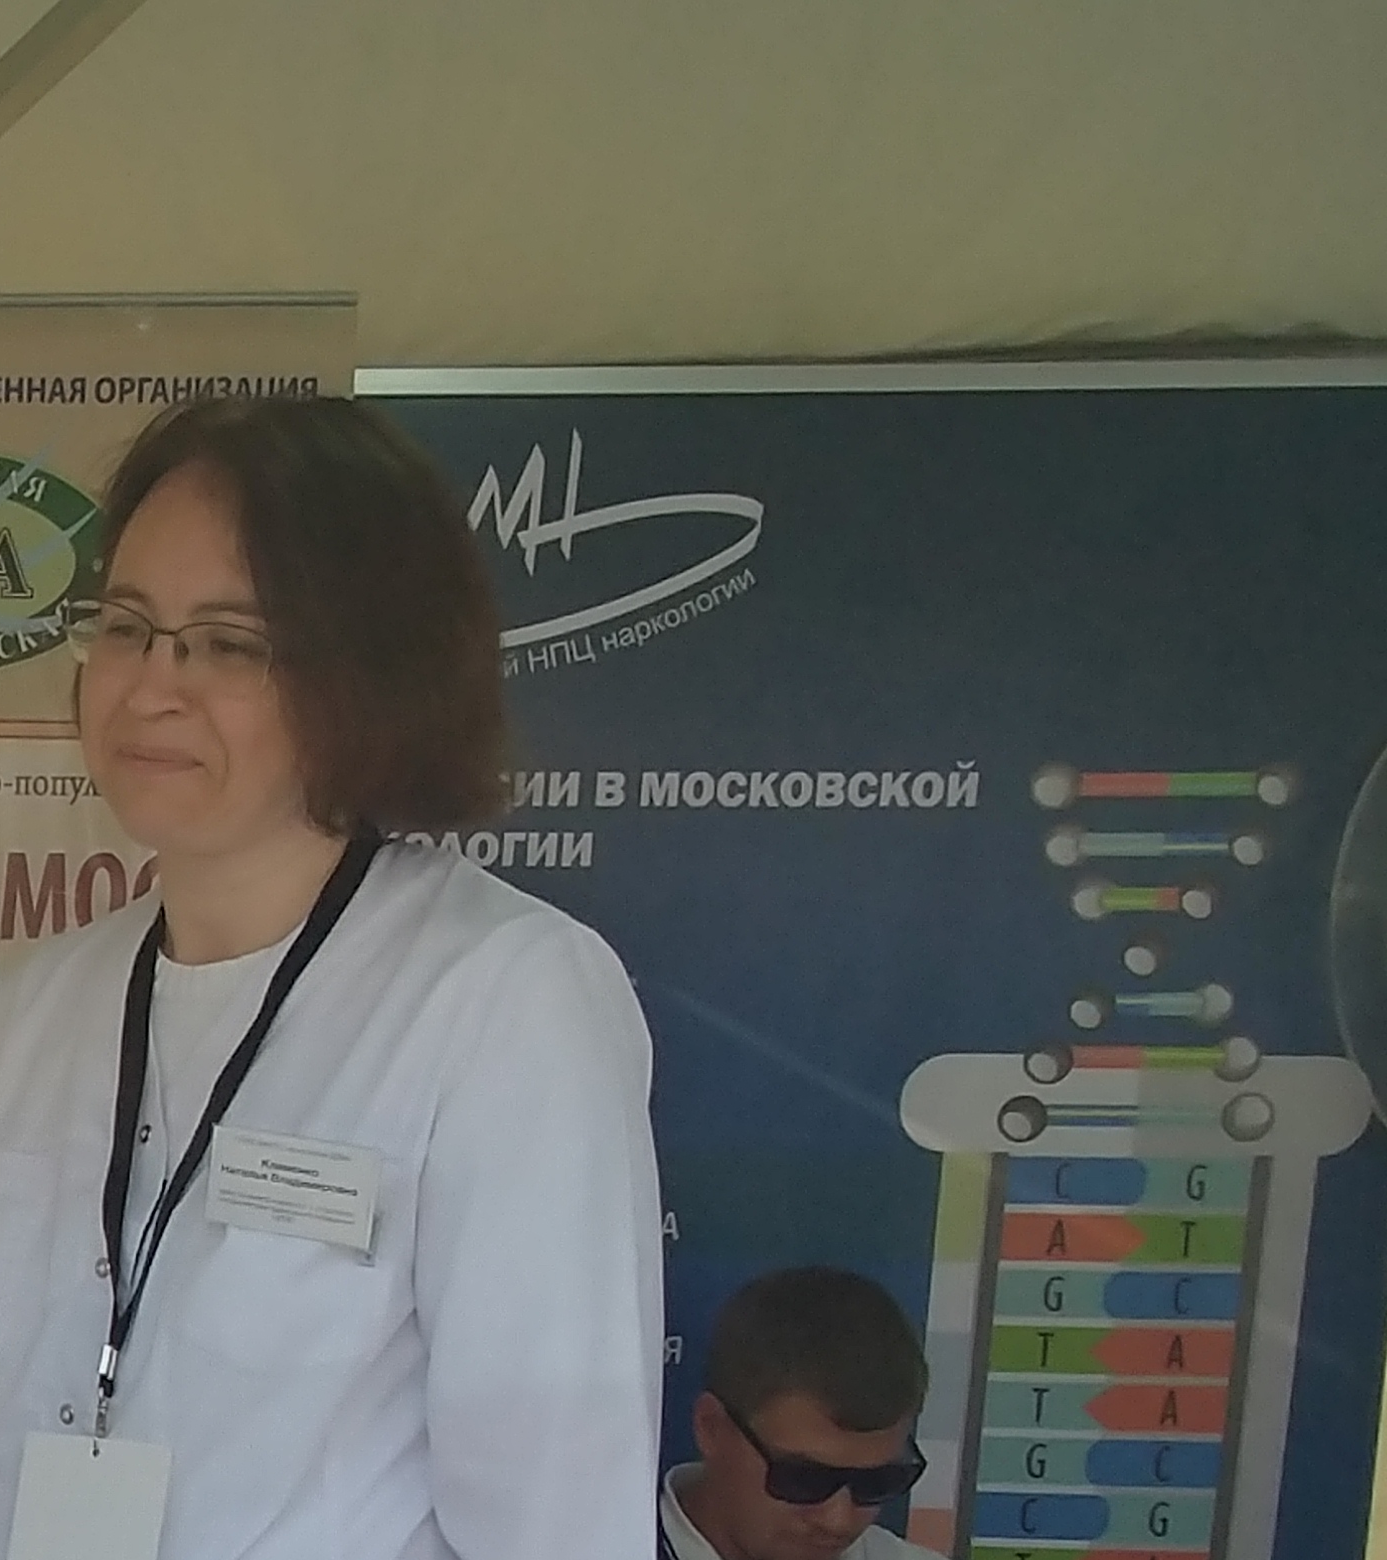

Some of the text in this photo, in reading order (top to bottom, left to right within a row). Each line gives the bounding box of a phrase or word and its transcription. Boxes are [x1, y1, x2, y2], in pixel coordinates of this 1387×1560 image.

[528, 634, 596, 673] НПЦ
[602, 568, 757, 651] наркологии
[499, 760, 980, 808] ИИ В МОСКОВСКОЙ
[1055, 1163, 1070, 1199] C
[1186, 1164, 1207, 1200] G
[1047, 1219, 1066, 1255] A
[1180, 1221, 1196, 1257] T
[1044, 1276, 1065, 1312] G
[1174, 1278, 1191, 1315] C
[1037, 1332, 1054, 1367] T
[1167, 1334, 1184, 1369] A
[1033, 1388, 1050, 1423] T
[1161, 1389, 1178, 1426] A
[1026, 1443, 1047, 1478] G
[1021, 1498, 1038, 1533] C
[1149, 1502, 1170, 1537] G
